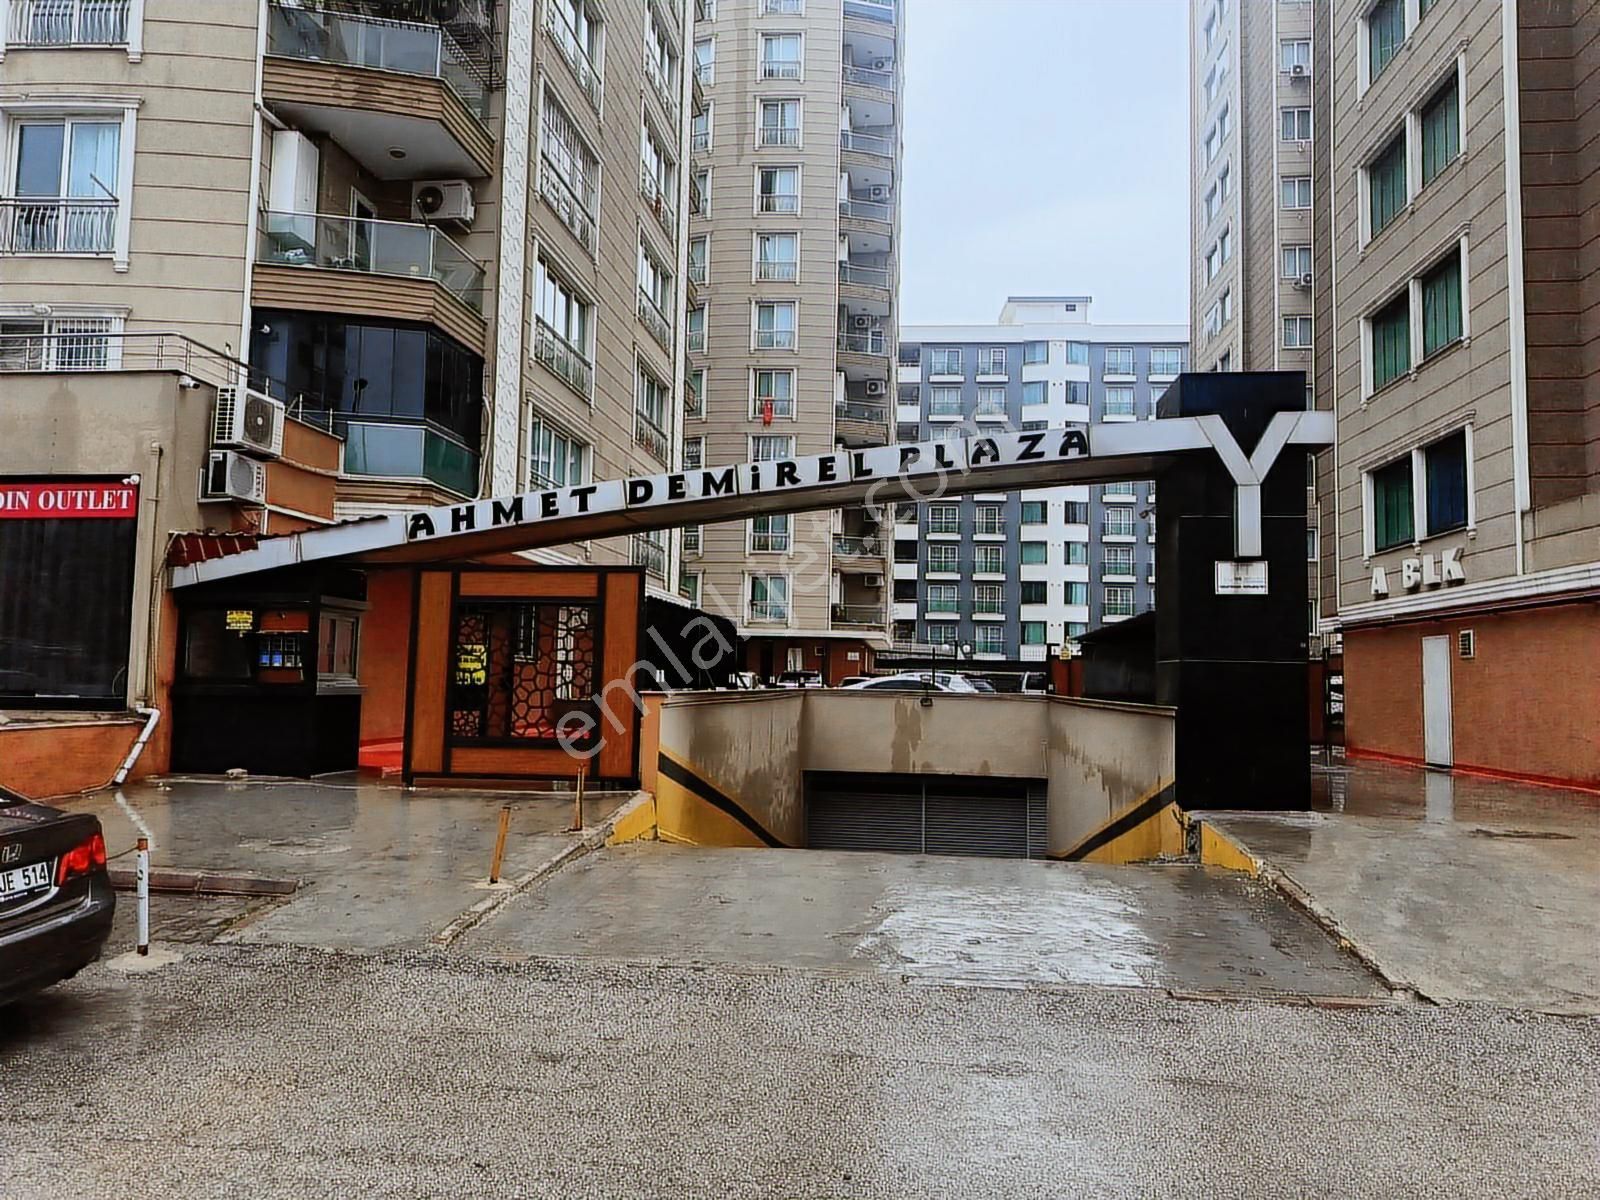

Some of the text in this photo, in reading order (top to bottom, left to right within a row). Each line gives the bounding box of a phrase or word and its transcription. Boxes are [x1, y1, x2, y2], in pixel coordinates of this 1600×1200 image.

[38, 490, 133, 510] OUTLET
[408, 486, 597, 540] AHMET
[899, 430, 1088, 474] PLAZA
[1371, 547, 1466, 595] A BLK
[22, 864, 47, 886] 514
